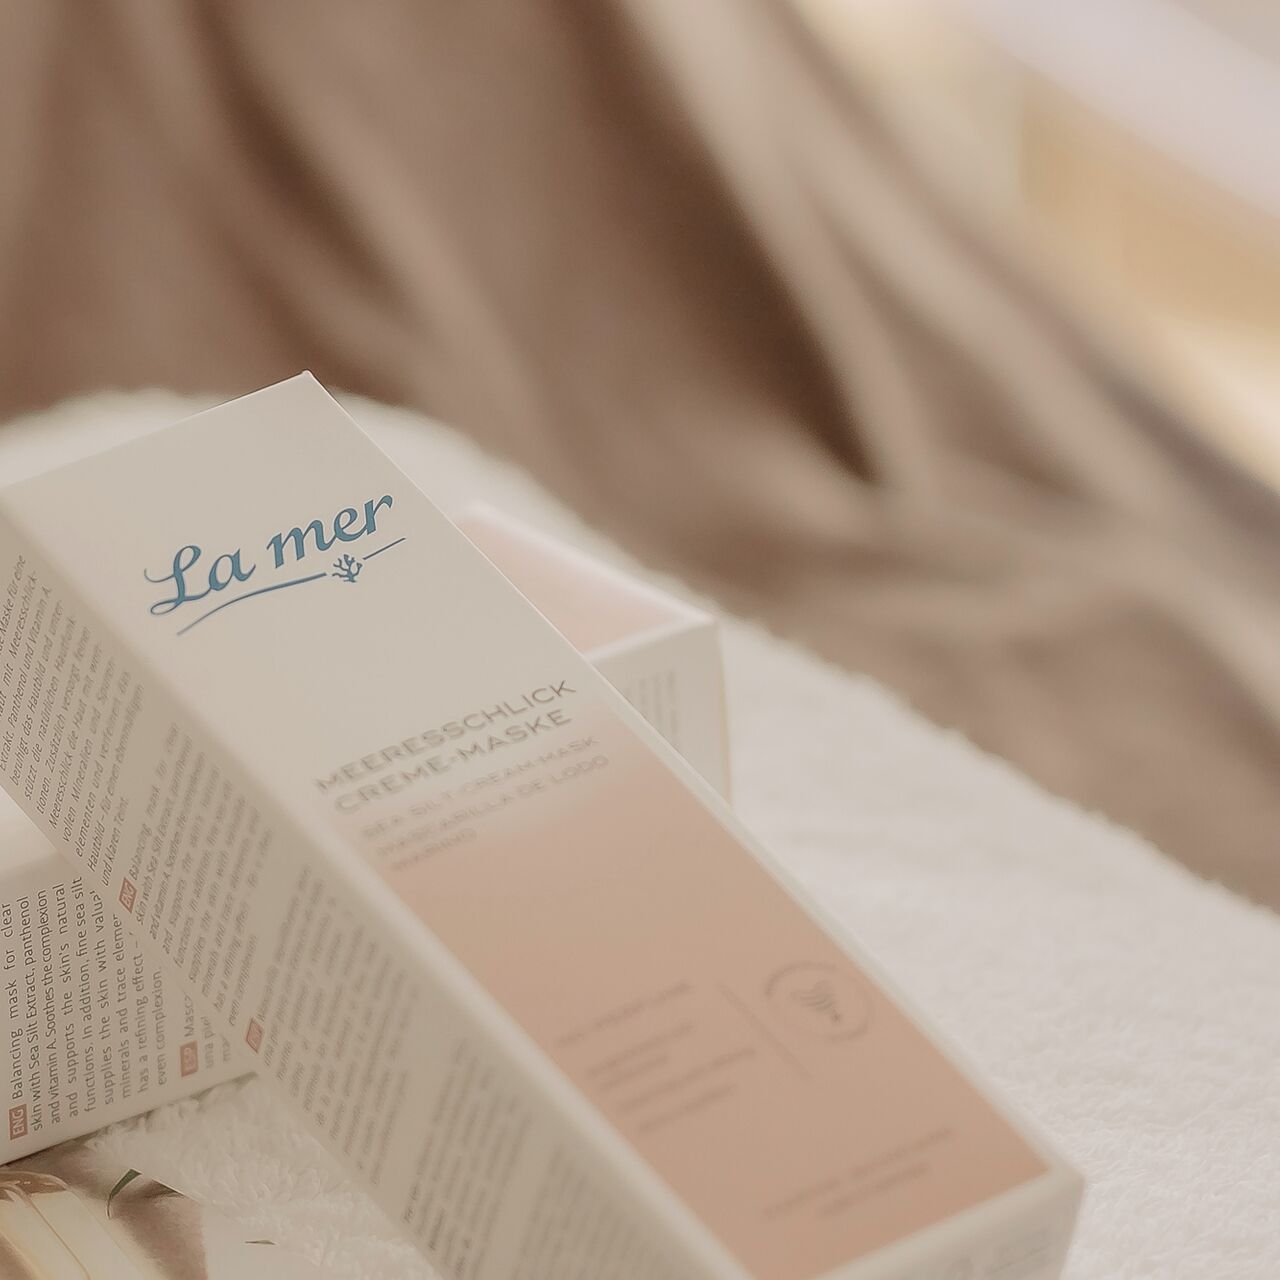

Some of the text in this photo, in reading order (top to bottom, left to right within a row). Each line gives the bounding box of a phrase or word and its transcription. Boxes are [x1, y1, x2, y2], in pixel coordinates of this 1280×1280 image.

[144, 495, 393, 615] La mer
[315, 680, 577, 792] MEERESSCHLICK
[334, 709, 573, 815] CREME-MASKE
[551, 754, 610, 784] LODO
[70, 875, 84, 899] silt
[0, 903, 13, 937] clear
[36, 889, 52, 962] complexion
[75, 902, 86, 927] sea
[2, 949, 15, 970] for
[75, 929, 87, 957] fine
[93, 938, 106, 972] with
[40, 963, 53, 986] the
[78, 959, 92, 1021] addition,
[116, 966, 127, 1003] trace
[131, 952, 144, 992] effect
[4, 979, 18, 1019] mask
[16, 895, 43, 1131] skin with Sea Silt Extract, panthenol
[42, 986, 56, 1037] Soothes
[52, 883, 79, 1117] and supports the skin's natural
[96, 978, 109, 1009] skin
[98, 1015, 111, 1040] the
[115, 1007, 128, 1033] and
[134, 995, 148, 1049] refining
[151, 966, 167, 1086] even complexion.
[9, 1027, 23, 1099] Balancing
[46, 1052, 59, 1099] vitamin
[83, 1042, 96, 1112] functions.
[100, 1045, 116, 1105] supplies
[117, 1039, 131, 1099] minerals
[136, 1067, 149, 1093] has
[47, 1100, 61, 1124] and
